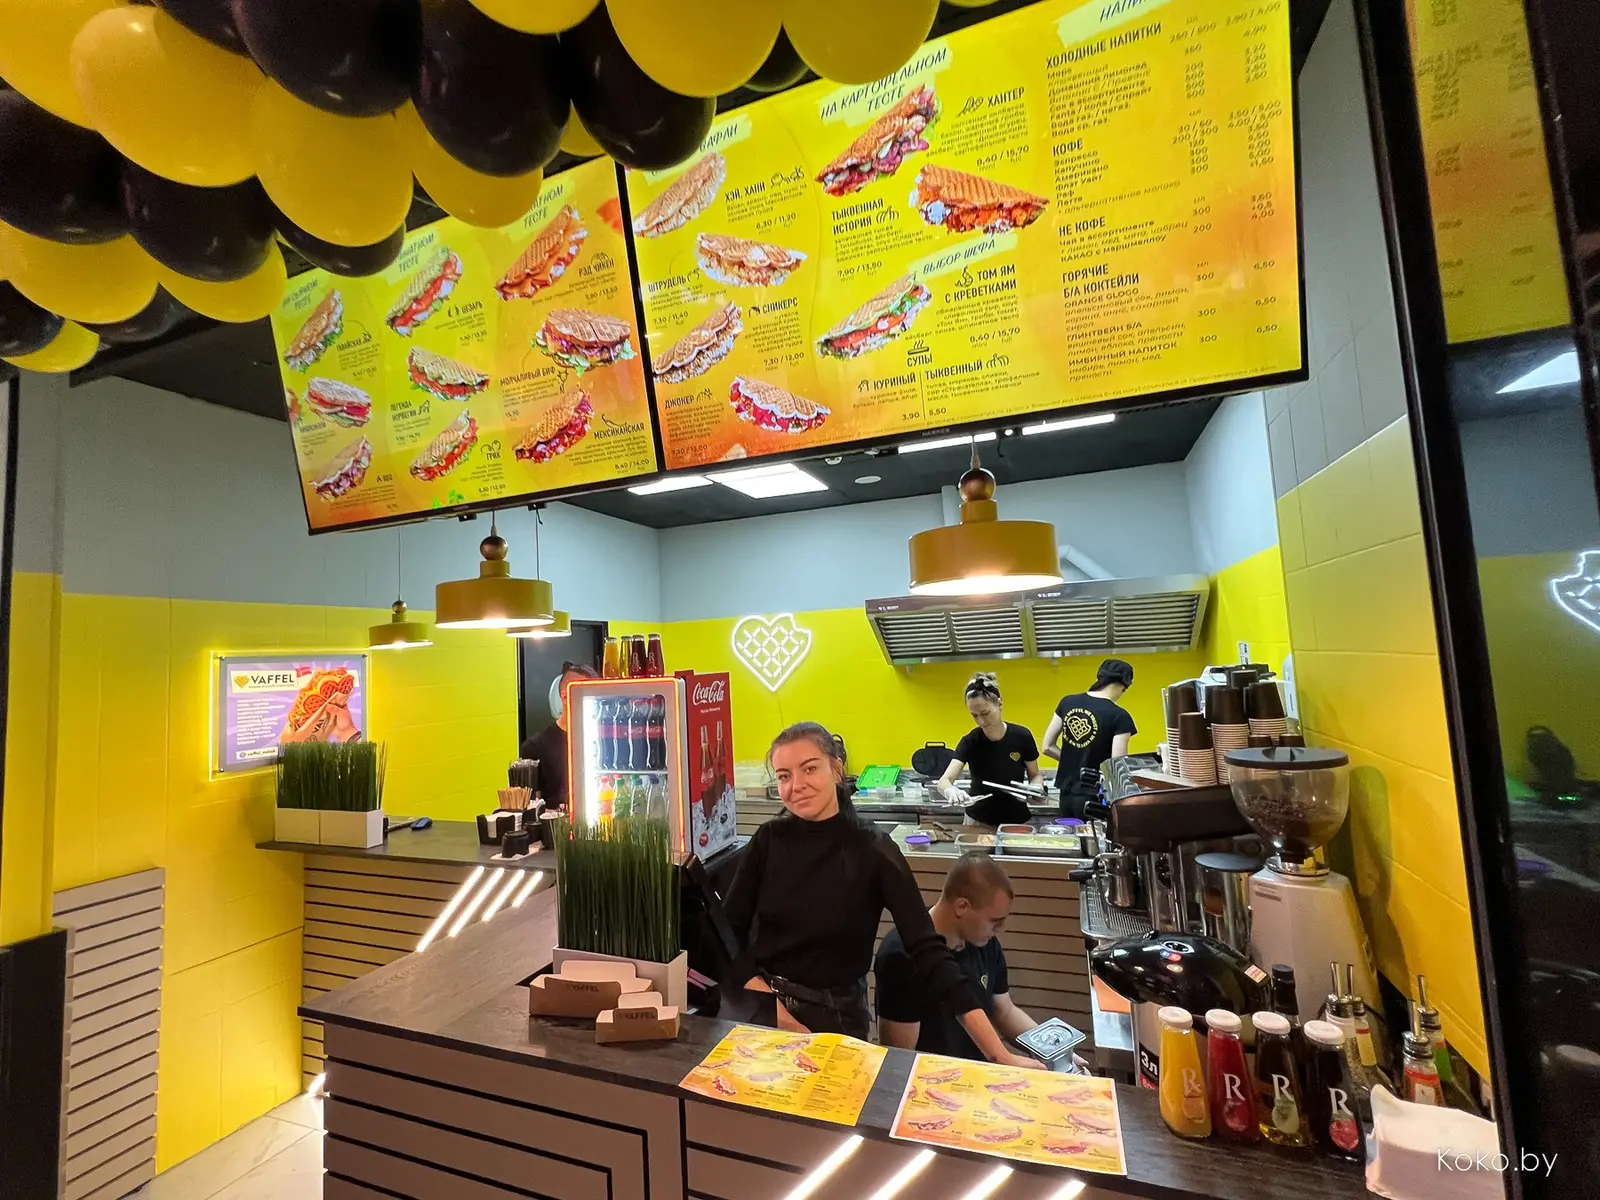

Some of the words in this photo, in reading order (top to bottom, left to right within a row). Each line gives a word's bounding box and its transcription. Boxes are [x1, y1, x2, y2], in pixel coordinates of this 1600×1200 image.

[1046, 39, 1106, 70] ХОЛОДНЫЕ
[1109, 20, 1162, 50] НАПИТКИ
[821, 101, 838, 120] НА
[841, 47, 948, 111] КАРТОФЕЛЬНОМ
[987, 86, 1026, 108] ХАНТЕР
[1053, 137, 1084, 158] КОФЕ
[1054, 150, 1099, 167] Эспрессо
[1055, 158, 1101, 176] Капучино
[1056, 165, 1110, 184] Американо
[831, 197, 885, 221] ТЫКВЕННАЯ
[832, 215, 873, 236] ИСТОРИЯ
[1059, 223, 1073, 238] НЕ
[1075, 216, 1106, 234] КОФЕ
[1087, 220, 1155, 241] ассортименте
[922, 251, 962, 275] ВЫБОР
[963, 239, 996, 260] ШЕФА
[1061, 250, 1094, 263] КАКАО
[578, 264, 594, 278] РЭД
[977, 267, 998, 282] ТОМ
[1000, 263, 1016, 279] ЯМ
[1062, 263, 1110, 284] ГОРЯЧИЕ
[648, 274, 687, 293] ШТРУДЕЛЬ
[945, 291, 953, 305] С
[954, 278, 1017, 303] КРЕВЕТКАМИ
[1063, 285, 1082, 300] Б/А
[1083, 271, 1140, 295] КОКТЕЙЛИ
[762, 296, 799, 315] СНИКЕРС
[1064, 295, 1105, 309] ORANGE
[1067, 324, 1125, 343] ГЛИНТВЕЙН
[907, 353, 934, 368] СУПЫ
[1069, 350, 1127, 368] ИМБИРНЫЙ
[1128, 341, 1178, 356] НАПИТОК
[541, 365, 557, 378] БИФ
[873, 371, 918, 391] КУРИНЫЙ
[925, 357, 984, 381] ТЫКВЕННЫЙ
[664, 394, 696, 410] ДЖОКЕР
[902, 411, 923, 423] 3,90
[928, 406, 948, 418] 5,50
[593, 421, 645, 441] МЕКСИКАНСКАЯ
[250, 674, 295, 685] VAFFEL
[692, 680, 726, 706] Coca-Cola
[1181, 1068, 1202, 1094] R
[1222, 1072, 1246, 1101] R
[1270, 1073, 1295, 1102] R
[1327, 1086, 1354, 1117] R
